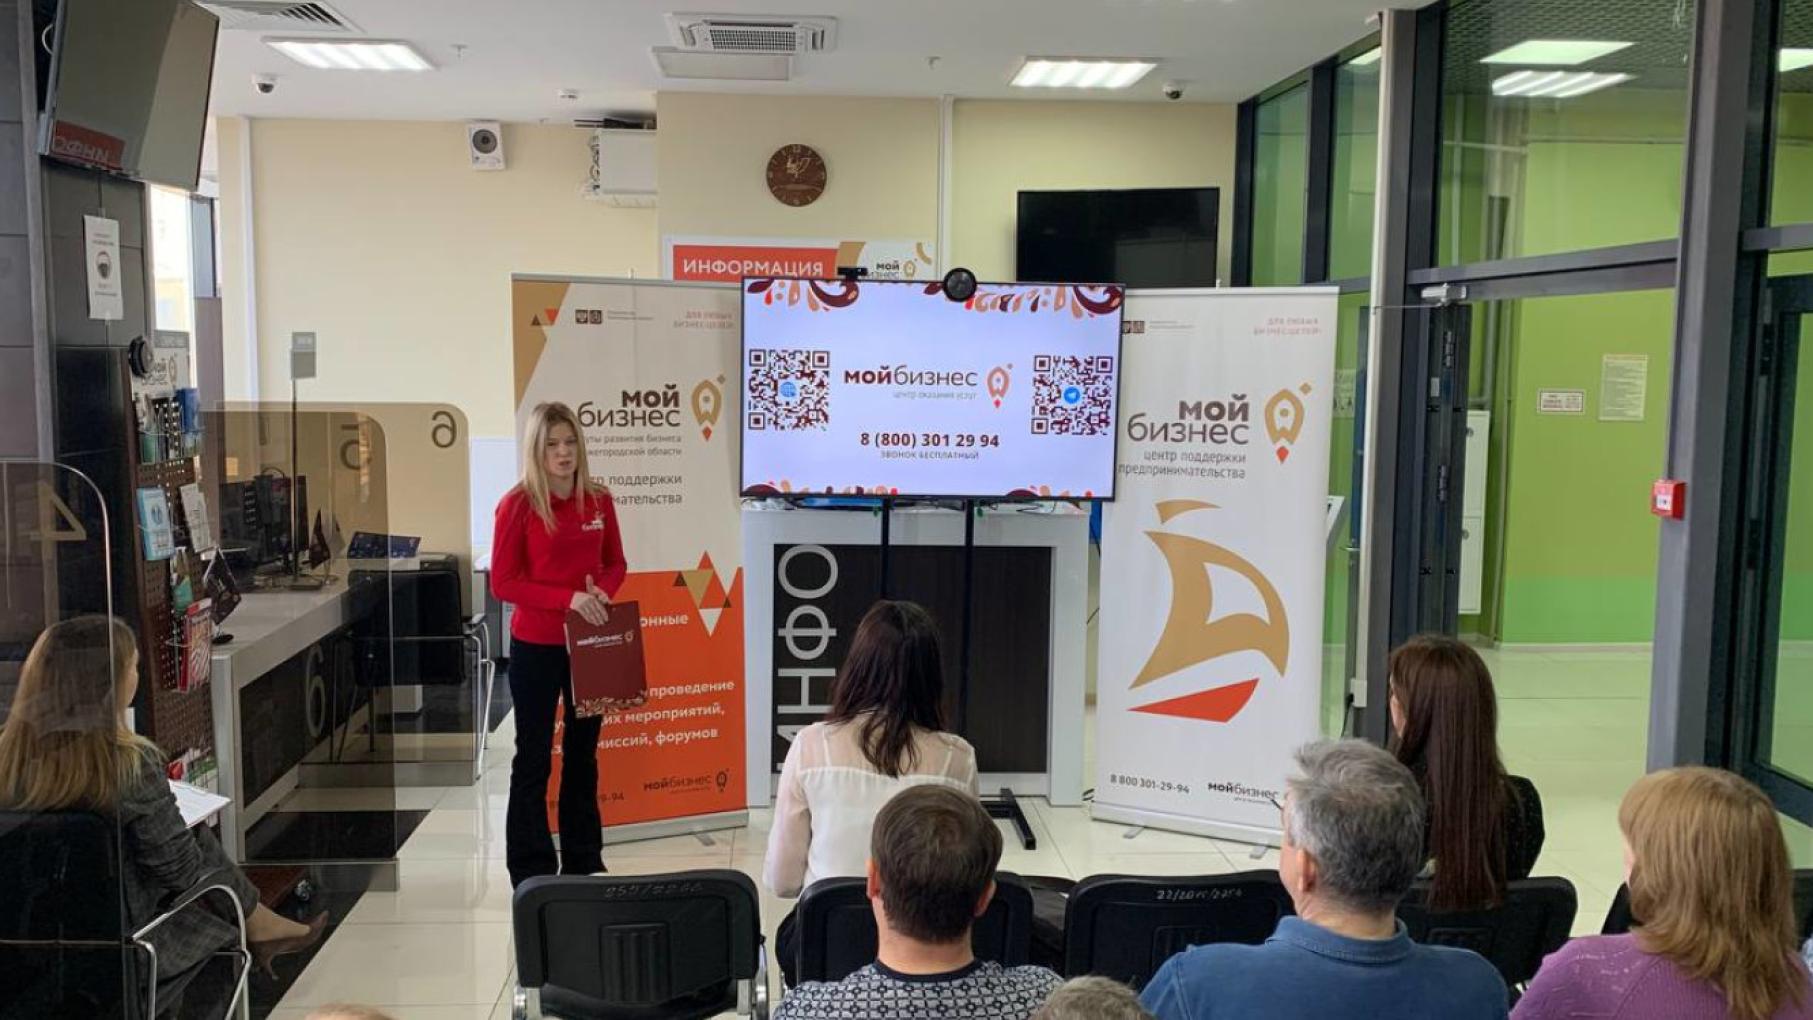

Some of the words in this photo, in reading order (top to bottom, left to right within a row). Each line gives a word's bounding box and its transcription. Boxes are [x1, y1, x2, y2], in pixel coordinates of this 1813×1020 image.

[683, 258, 824, 278] ИНФОРМАЦИЯ
[844, 364, 978, 386] мойбизнес
[621, 383, 680, 408] мой
[577, 401, 681, 428] бизнес
[1179, 393, 1249, 422] мой
[1127, 412, 1250, 445] бизнес
[604, 436, 644, 444] развития
[646, 434, 682, 443] бизнеса
[861, 433, 870, 446] 8
[875, 432, 917, 449] (800)
[921, 433, 950, 447] 301
[955, 434, 975, 447] 29
[980, 434, 1000, 447] 94
[647, 447, 682, 456] области
[881, 451, 917, 459] ЗВОНОК
[919, 450, 979, 460] БЕСПЛАТНЫЙ
[1144, 450, 1177, 462] центр
[1181, 451, 1246, 465] поддержки
[1117, 463, 1246, 479] предпринимательства
[609, 475, 682, 487] поддержки
[640, 614, 688, 627] онные
[650, 680, 735, 698] проведение
[624, 702, 725, 724] мероприятий,
[655, 729, 719, 747] форумов
[1110, 774, 1117, 783] 8
[1119, 774, 1138, 787] 800
[1140, 777, 1190, 794] 301-29-94
